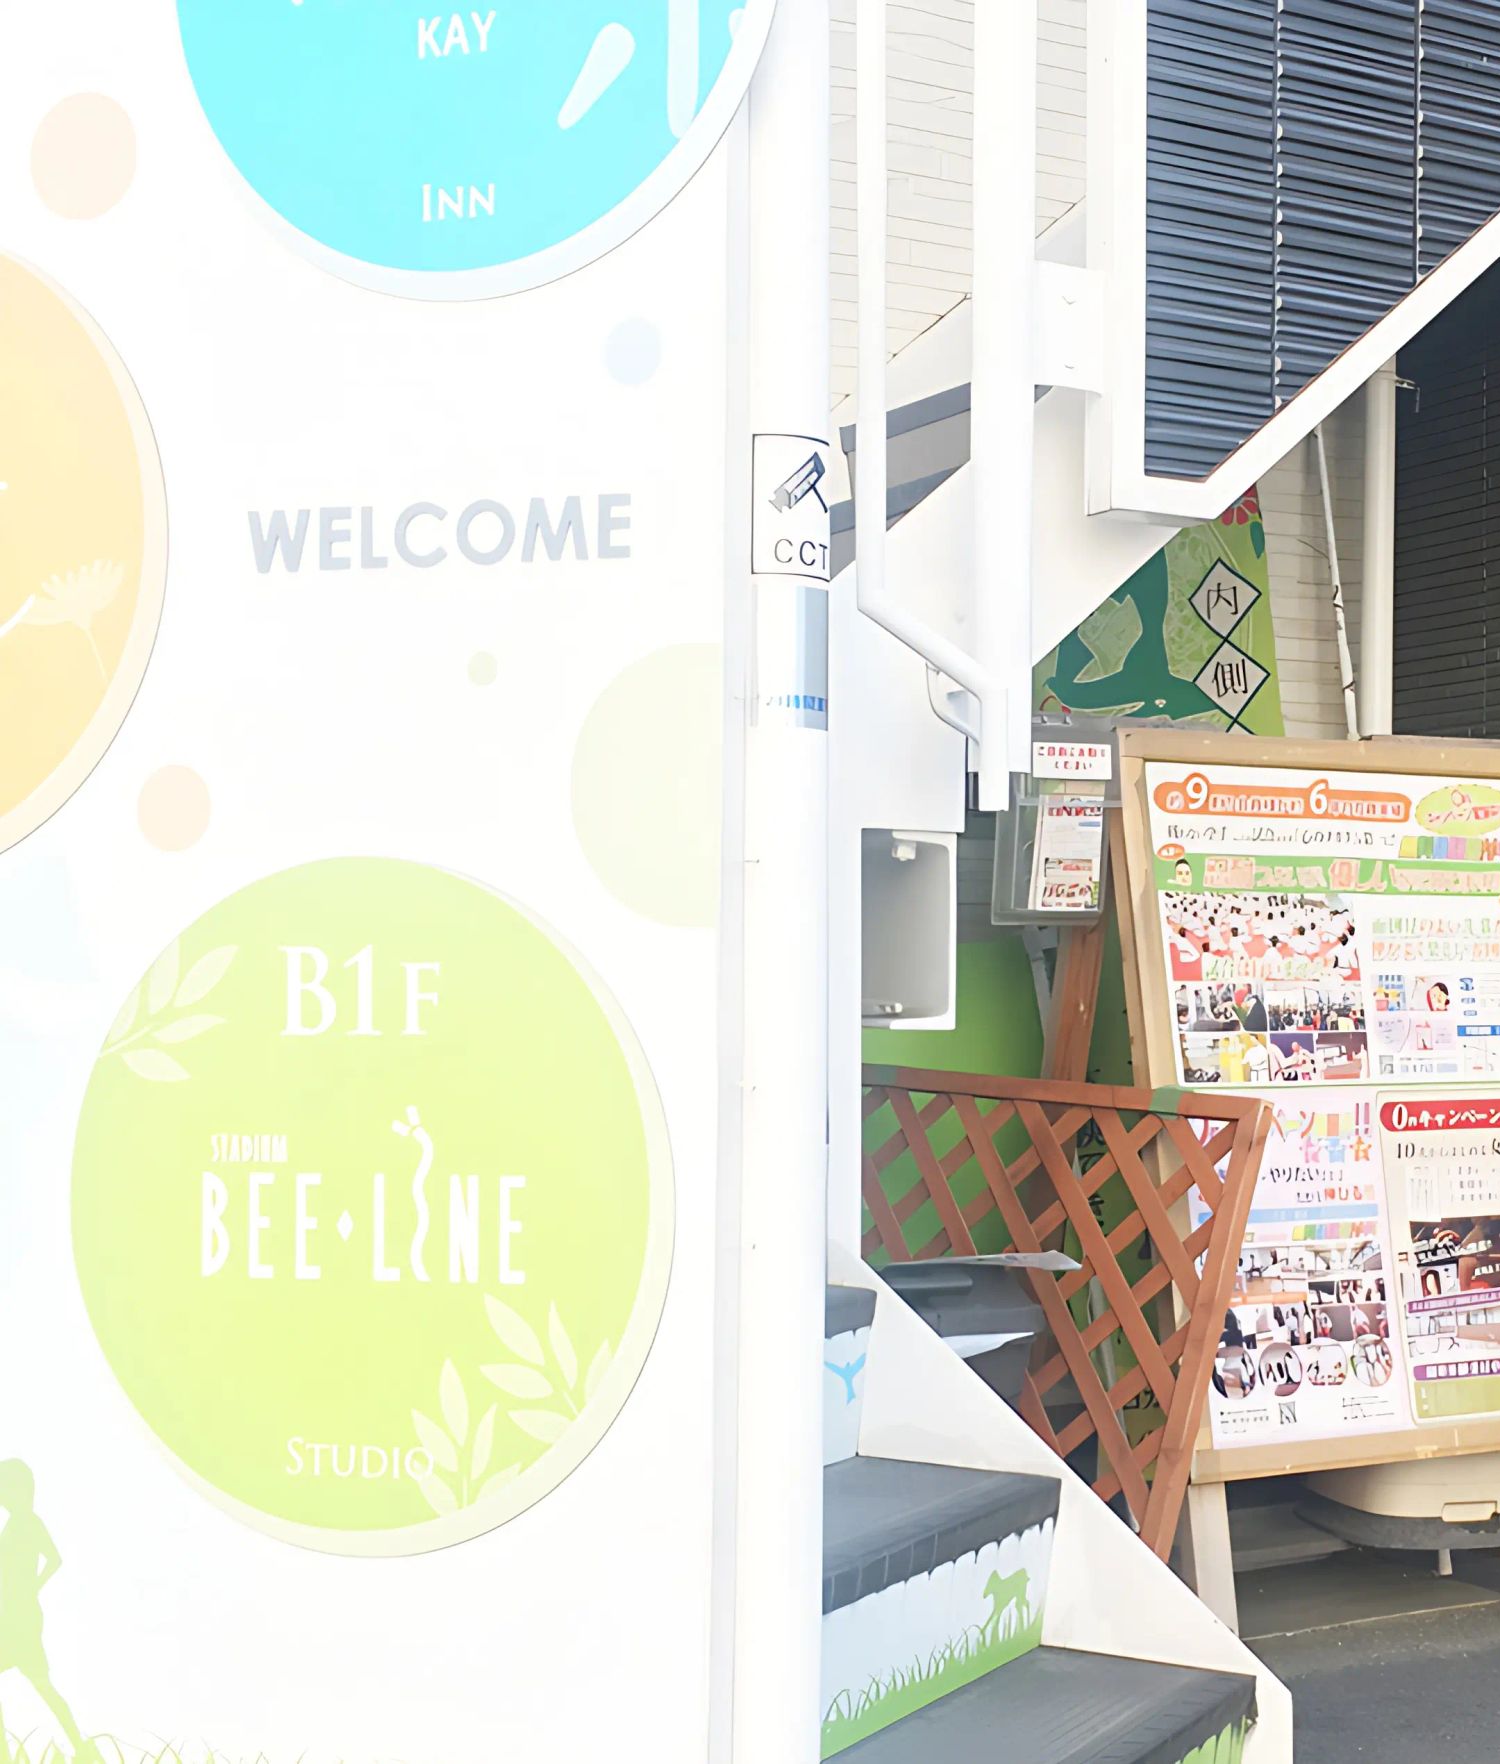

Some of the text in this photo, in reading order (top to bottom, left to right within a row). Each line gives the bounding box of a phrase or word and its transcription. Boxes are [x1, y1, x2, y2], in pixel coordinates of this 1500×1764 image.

[417, 9, 497, 60] KAY
[421, 182, 497, 223] INN
[247, 492, 632, 575] WELCOME
[278, 943, 442, 1037] B1F
[285, 1436, 435, 1482] STUDIO
